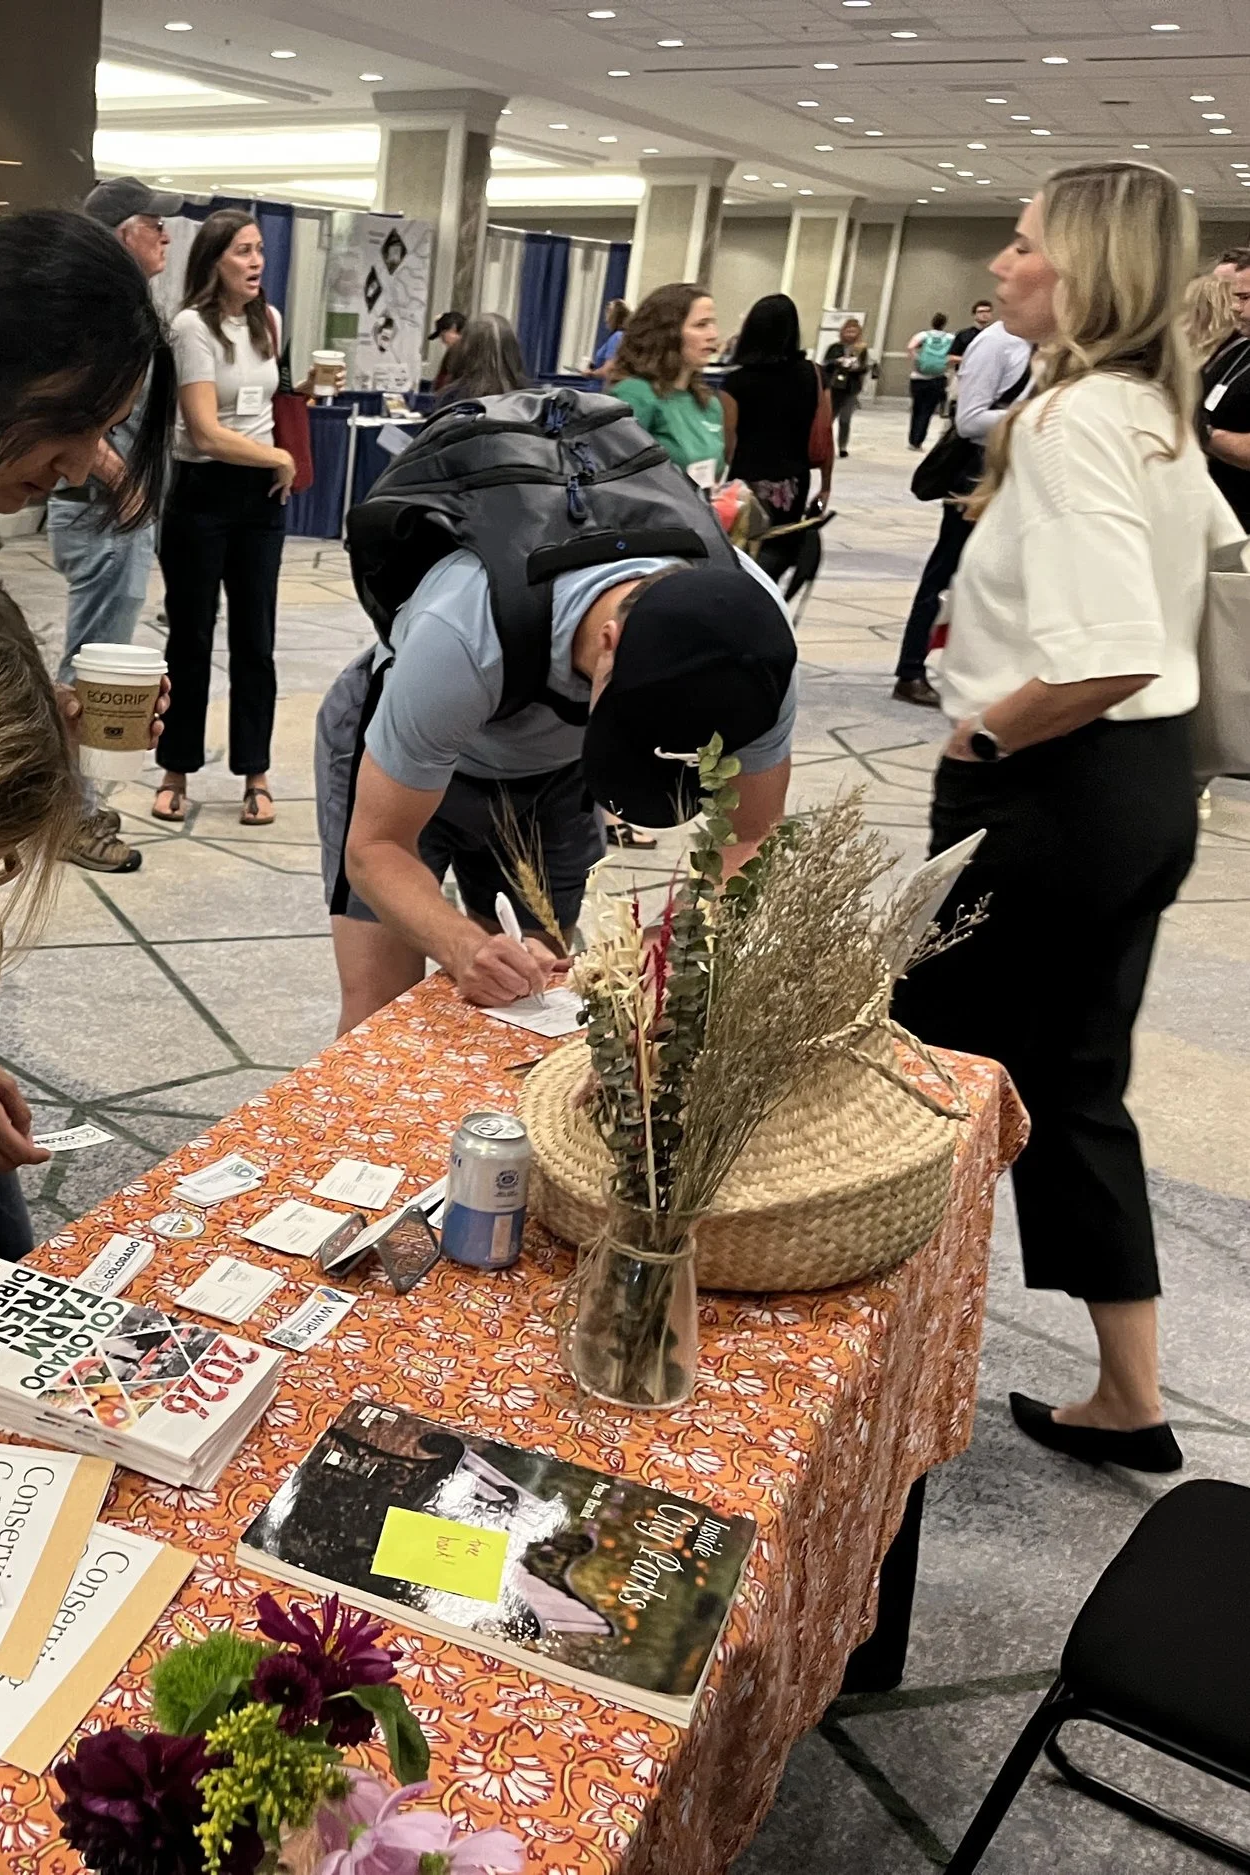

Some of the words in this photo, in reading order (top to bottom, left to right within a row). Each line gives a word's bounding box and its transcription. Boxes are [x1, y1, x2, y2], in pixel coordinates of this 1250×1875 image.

[104, 1241, 141, 1279] COLORADO
[11, 1288, 103, 1360] FARM
[20, 1301, 124, 1390] COLORADO
[298, 1306, 337, 1336] WWIRC
[161, 1337, 260, 1420] 2026
[634, 1504, 699, 1546] City
[693, 1518, 731, 1558] Inside
[618, 1545, 685, 1610] Parks
